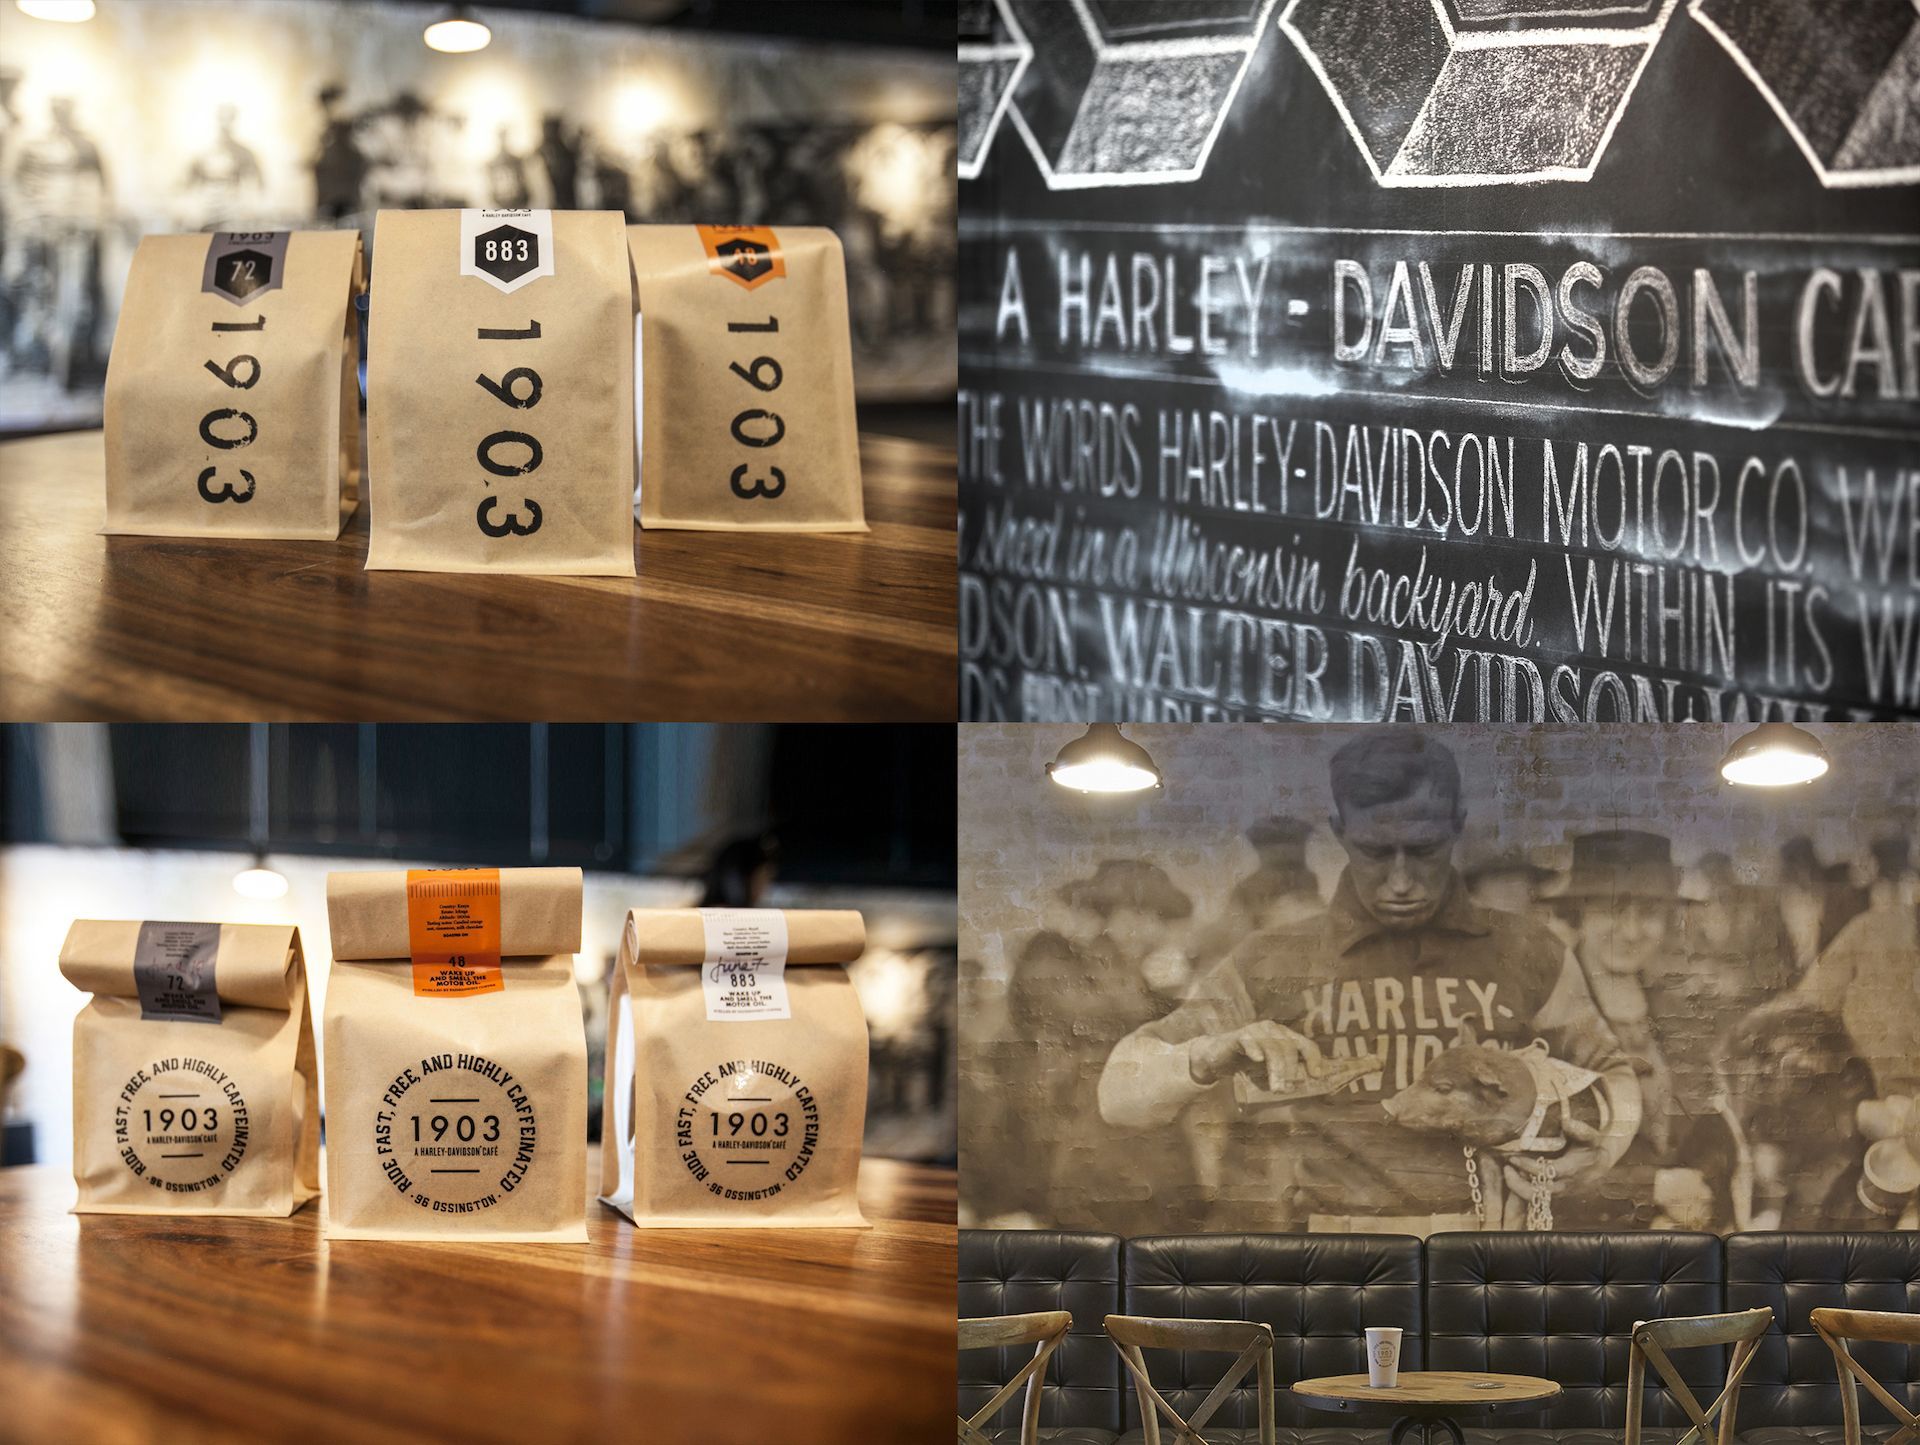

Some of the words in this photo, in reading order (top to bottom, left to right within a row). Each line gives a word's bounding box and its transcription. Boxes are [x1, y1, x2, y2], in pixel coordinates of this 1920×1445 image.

[485, 240, 528, 261] 883
[231, 261, 256, 282] 72
[997, 249, 1030, 346] A
[1057, 248, 1270, 358] HARLEY
[1334, 258, 1760, 388] DAVIDSON
[197, 314, 266, 504] 1903
[727, 315, 786, 500] 1903
[475, 319, 543, 537] 1903
[1018, 396, 1143, 499] WORDS
[1158, 409, 1514, 538] HARLEY-DAVIDSON
[1543, 438, 1720, 564] MOTOR
[1734, 456, 1814, 575] CO.
[1067, 505, 1107, 586] in
[1111, 528, 1140, 590] a
[1150, 508, 1326, 614] Wisconsin
[1340, 533, 1543, 662] backyard.
[1565, 552, 1735, 681] WITHIN
[1766, 579, 1834, 694] ITS
[1099, 592, 1334, 720] WALTER
[449, 956, 465, 967] 48
[167, 975, 184, 991] 72
[730, 973, 756, 988] 883
[152, 1057, 179, 1076] AND
[182, 1057, 228, 1085] HIGHLY
[421, 1053, 453, 1076] AND
[457, 1053, 513, 1088] HIGHLY
[718, 1060, 747, 1079] AND
[751, 1060, 801, 1089] HIGHLY
[121, 1070, 152, 1103] FREE,
[383, 1068, 421, 1107] FREE,
[685, 1071, 719, 1105] FREE,
[115, 1106, 131, 1144] FAST,
[143, 1107, 218, 1132] 1903
[221, 1081, 249, 1172] CAFFEINATED
[376, 1111, 396, 1155] FAST,
[410, 1115, 500, 1142] 1903
[677, 1107, 697, 1147] FAST,
[710, 1112, 789, 1136] 1903
[785, 1086, 819, 1181] CAFFEINATED
[414, 1148, 419, 1156] A
[500, 1084, 536, 1192] CAFFEINATED
[712, 1141, 717, 1149] A
[121, 1146, 147, 1176] RIDE
[382, 1158, 413, 1193] RIDE
[682, 1150, 709, 1182] RIDE
[150, 1176, 163, 1188] 96
[165, 1175, 221, 1193] OSSINGTON
[709, 1182, 724, 1195] 96
[725, 1183, 782, 1200] OSSINGTON
[414, 1194, 430, 1207] 96
[432, 1194, 497, 1213] OSSINGTON
